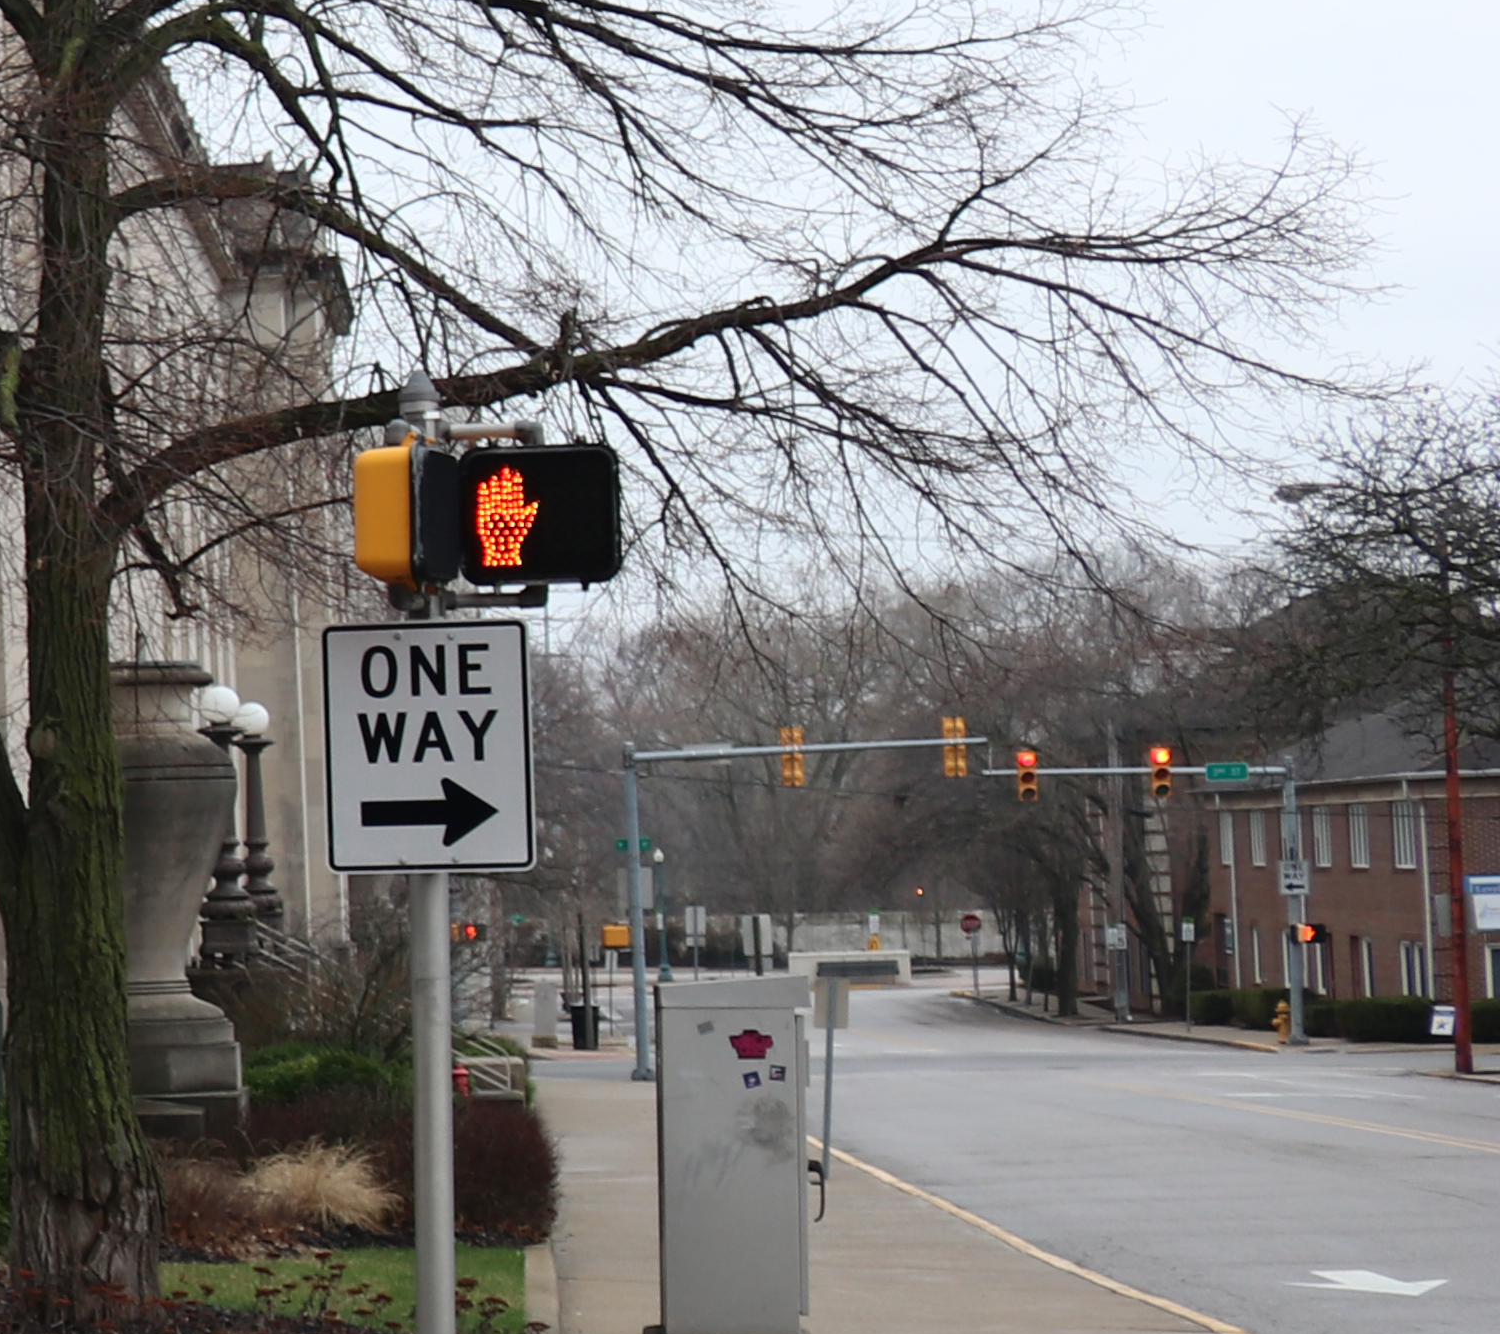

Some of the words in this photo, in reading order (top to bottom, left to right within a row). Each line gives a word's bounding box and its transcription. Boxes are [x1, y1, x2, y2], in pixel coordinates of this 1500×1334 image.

[361, 643, 492, 698] ONE
[357, 709, 499, 764] WAY
[1283, 862, 1303, 871] ONE
[1283, 872, 1305, 880] WAY
